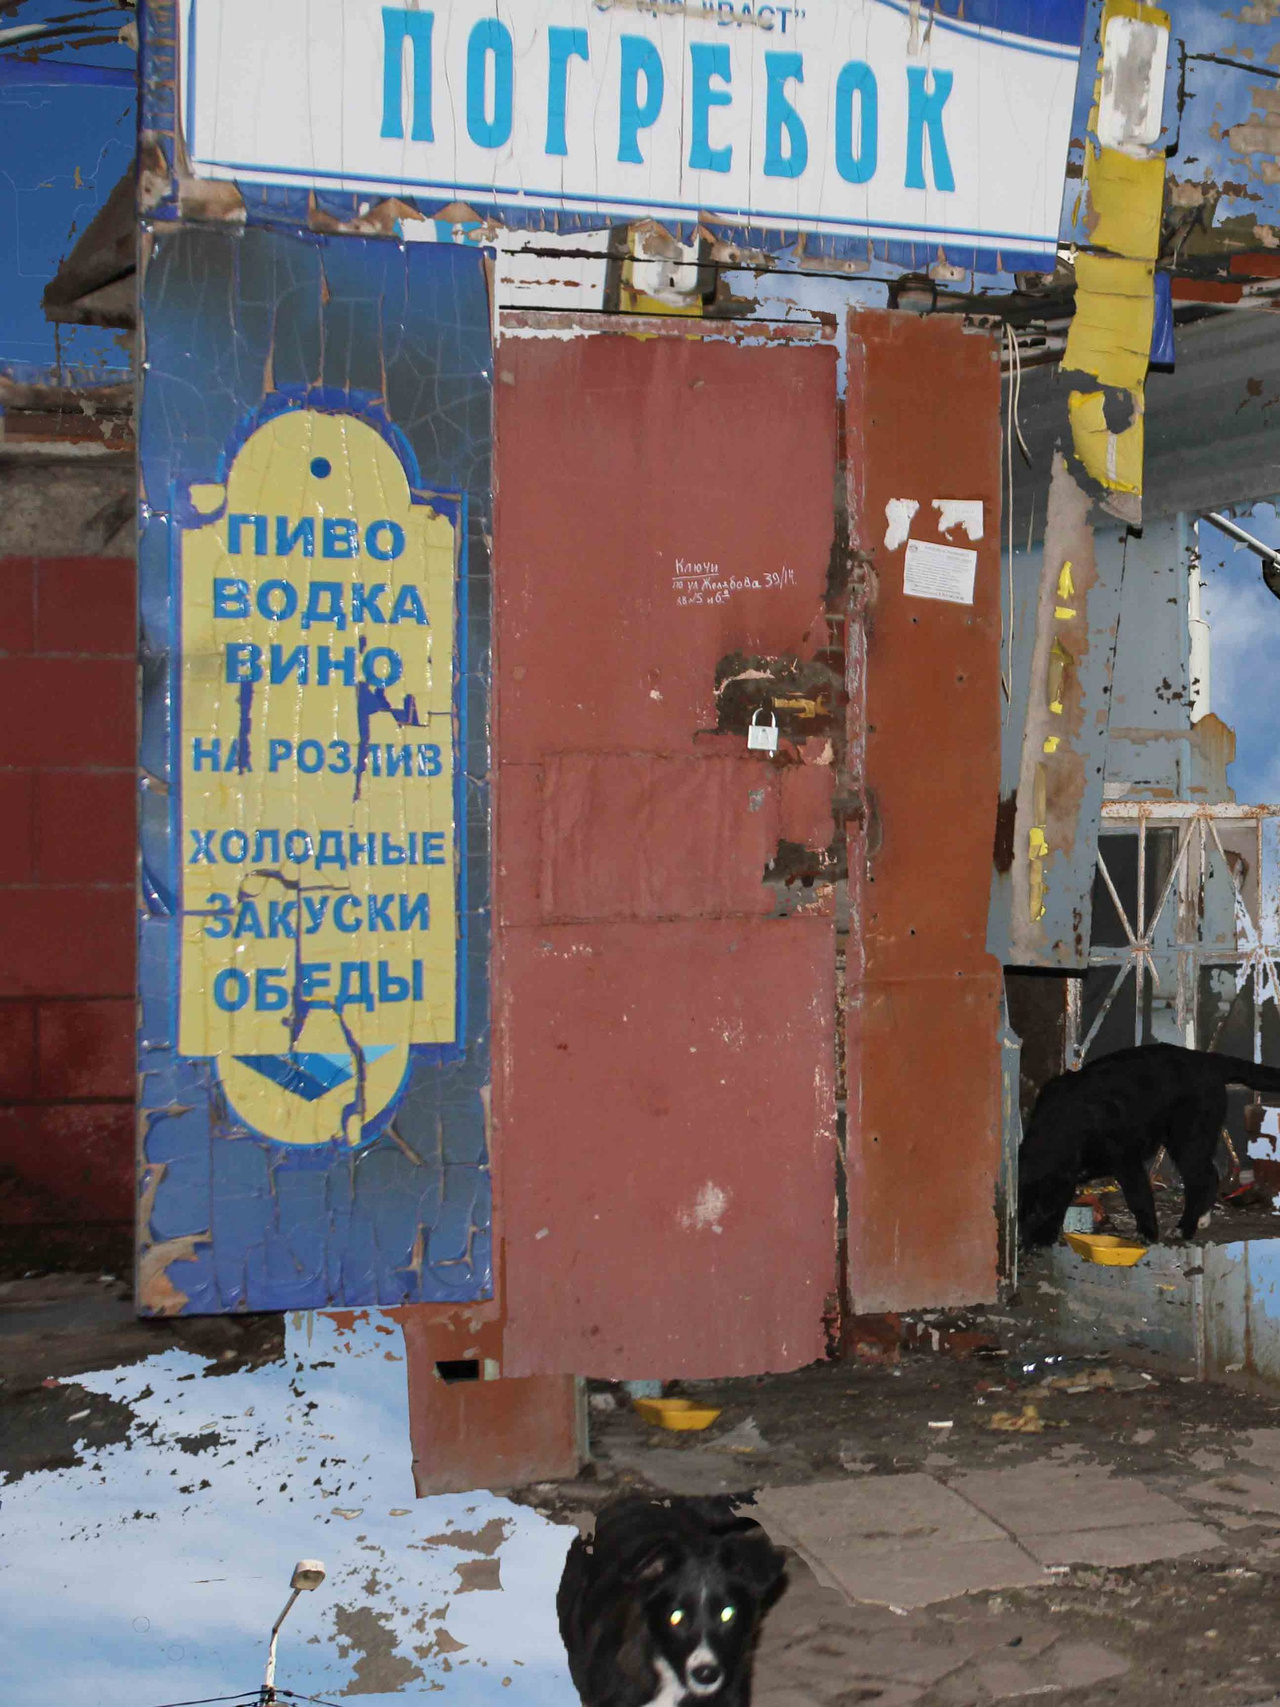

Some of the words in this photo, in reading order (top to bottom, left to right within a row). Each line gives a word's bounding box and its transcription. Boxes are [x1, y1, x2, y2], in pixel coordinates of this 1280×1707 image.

[380, 5, 955, 192] ПОГРЕБОК
[228, 513, 406, 561] ПИВО
[675, 558, 719, 576] Ключи
[213, 578, 430, 631] ВОДКА
[226, 643, 403, 688] ВИНО
[192, 738, 252, 773] НА
[269, 739, 443, 778] РОЗЛИВ
[188, 829, 446, 870] ХОЛОДНЫЕ
[204, 892, 430, 939] ЗАКУСКИ
[213, 959, 424, 1013] ОБЕДЫ
